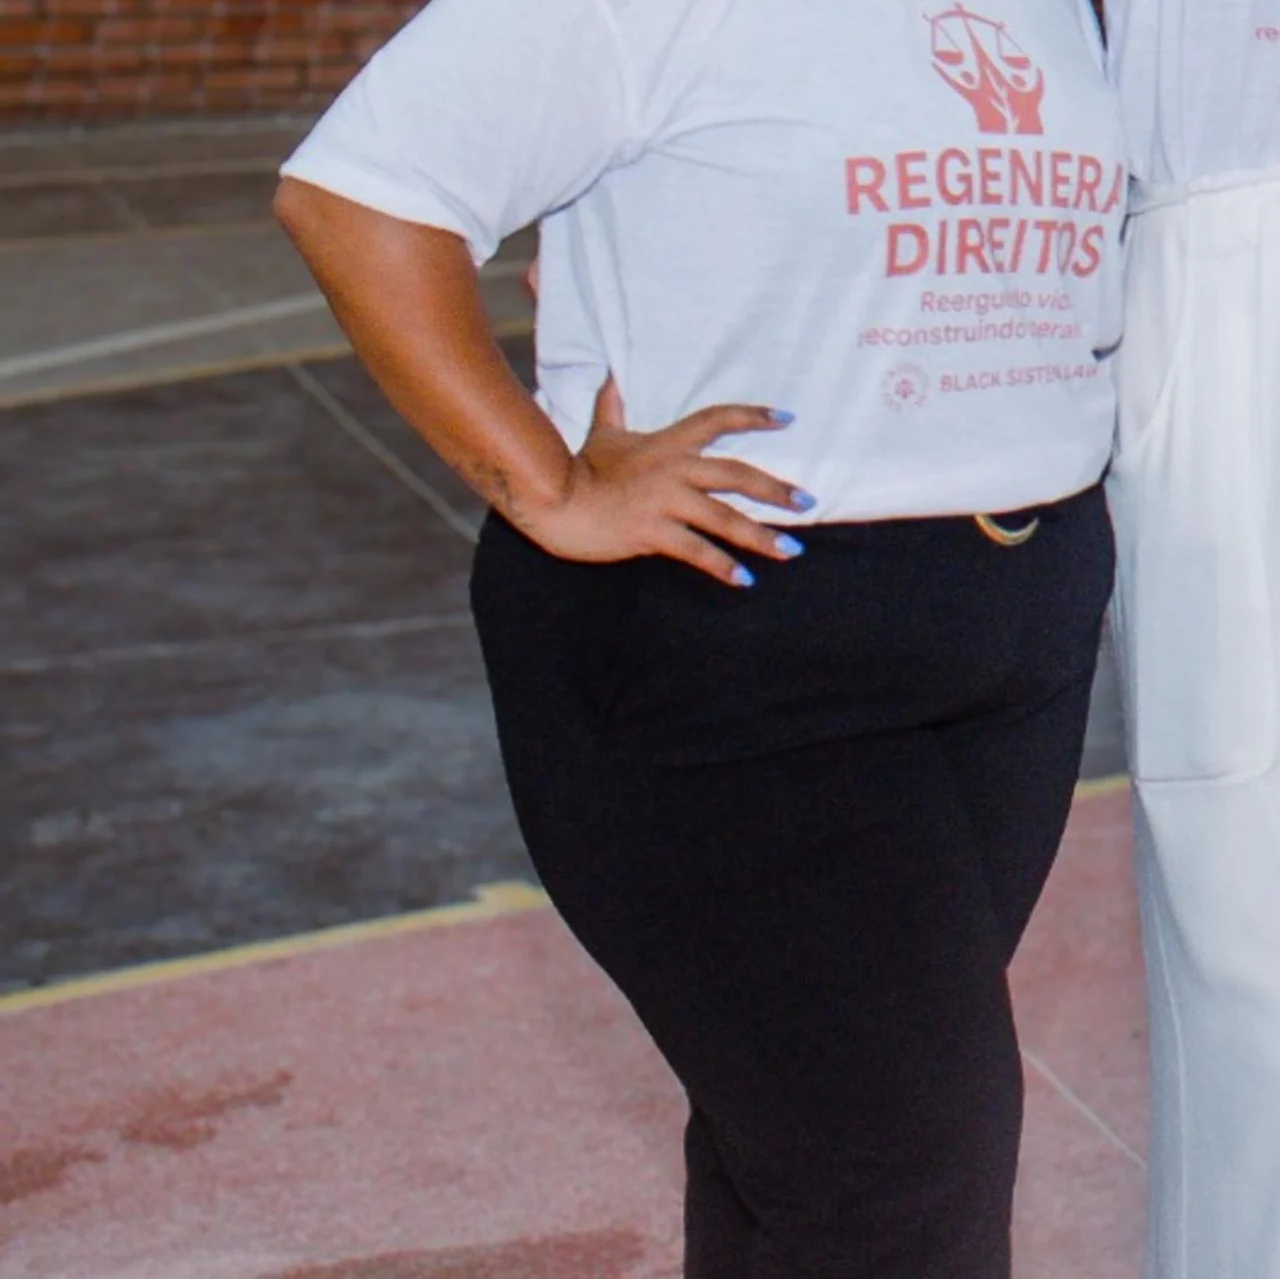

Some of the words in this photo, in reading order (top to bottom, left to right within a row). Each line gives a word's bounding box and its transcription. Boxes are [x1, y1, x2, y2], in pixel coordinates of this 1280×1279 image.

[844, 148, 1123, 215] REGENERA
[886, 218, 1105, 278] DIREITOS
[940, 371, 1001, 393] BLACK
